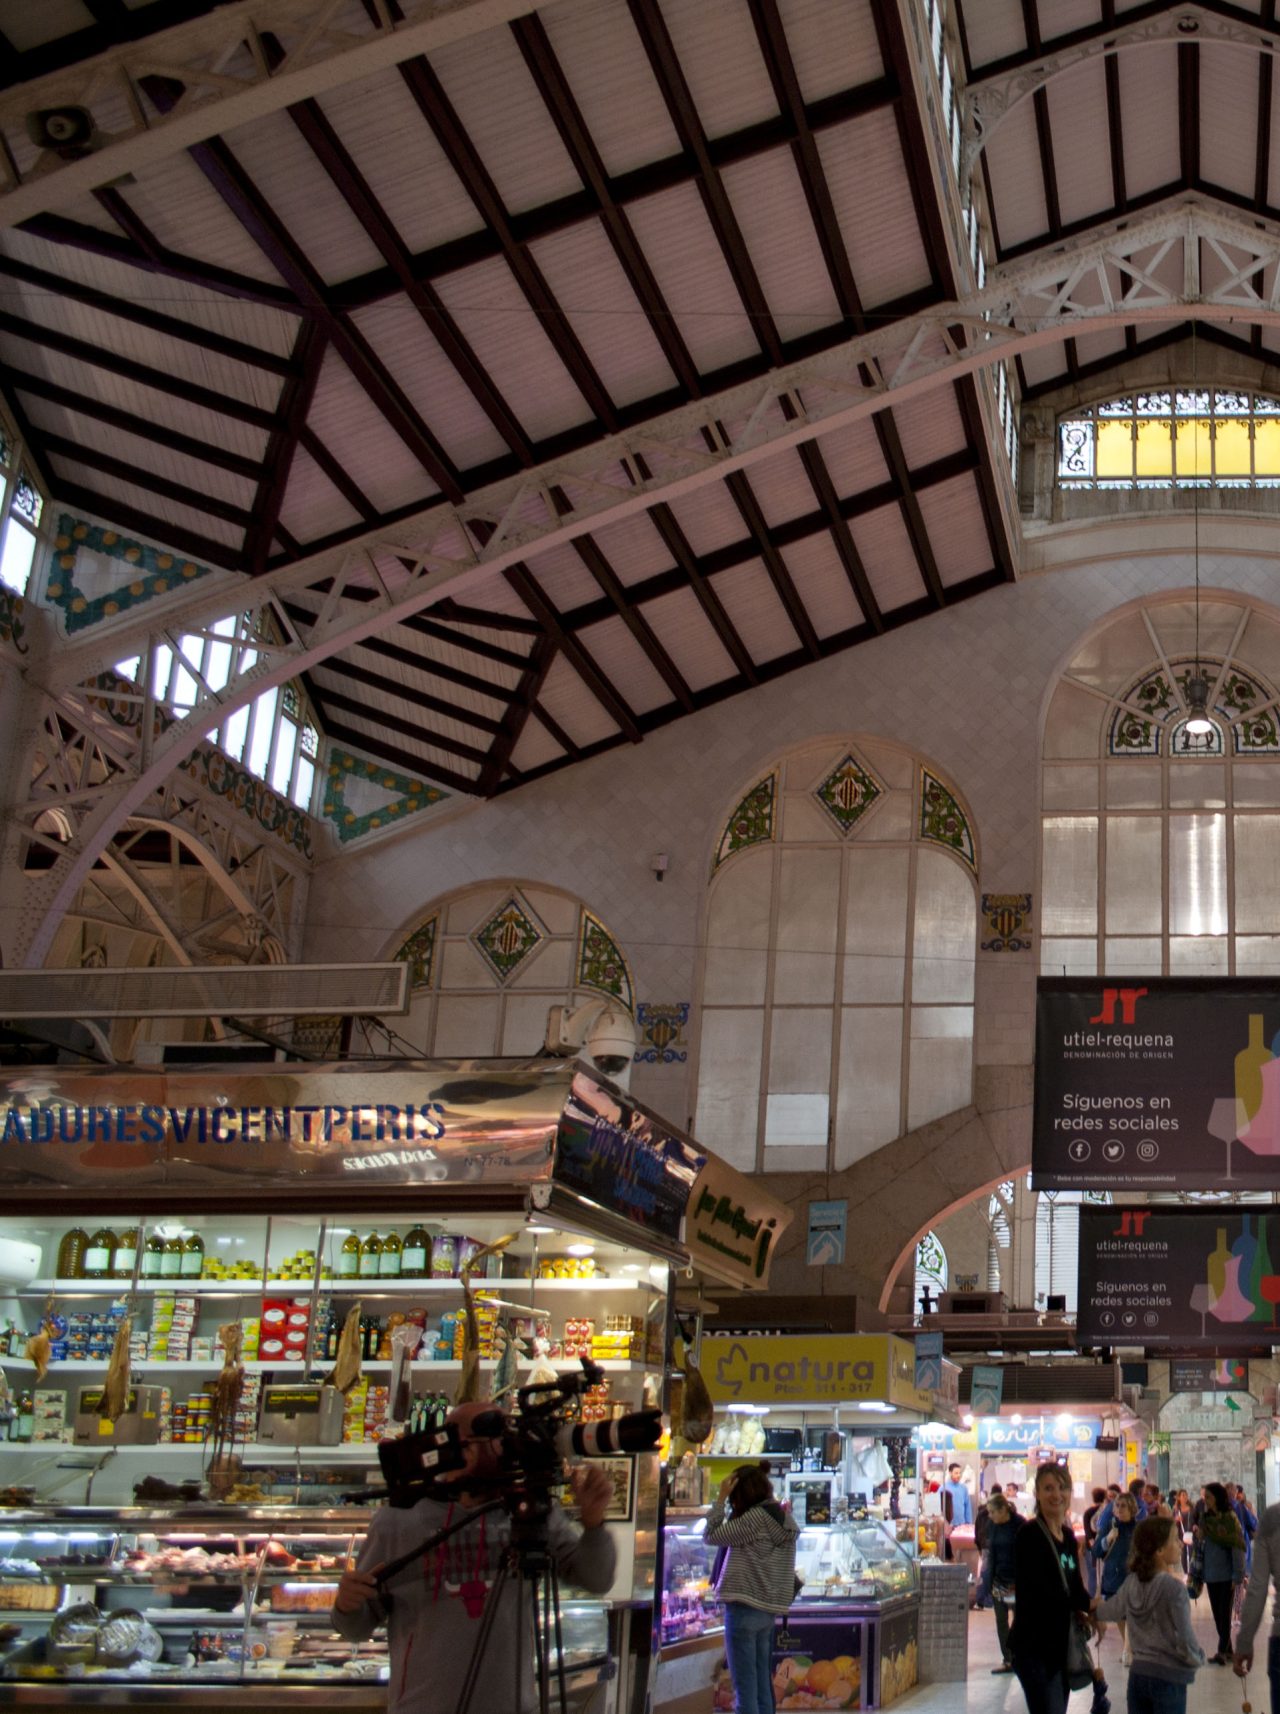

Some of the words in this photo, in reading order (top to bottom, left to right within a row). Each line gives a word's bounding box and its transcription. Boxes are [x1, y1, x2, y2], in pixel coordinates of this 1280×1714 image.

[1064, 1032, 1174, 1049] utiel-requena
[1064, 1051, 1126, 1059] DENOMINACIÓN
[1063, 1094, 1144, 1111] Síguenos
[1150, 1096, 1171, 1109] en
[1054, 1115, 1103, 1130] redes
[1109, 1115, 1179, 1130] sociales
[1096, 1240, 1168, 1252] utiel-requena
[1096, 1281, 1149, 1293] Síguenos
[1152, 1283, 1167, 1292] en
[1090, 1296, 1123, 1306] redes
[1126, 1296, 1172, 1306] sociales
[750, 1357, 874, 1383] natura
